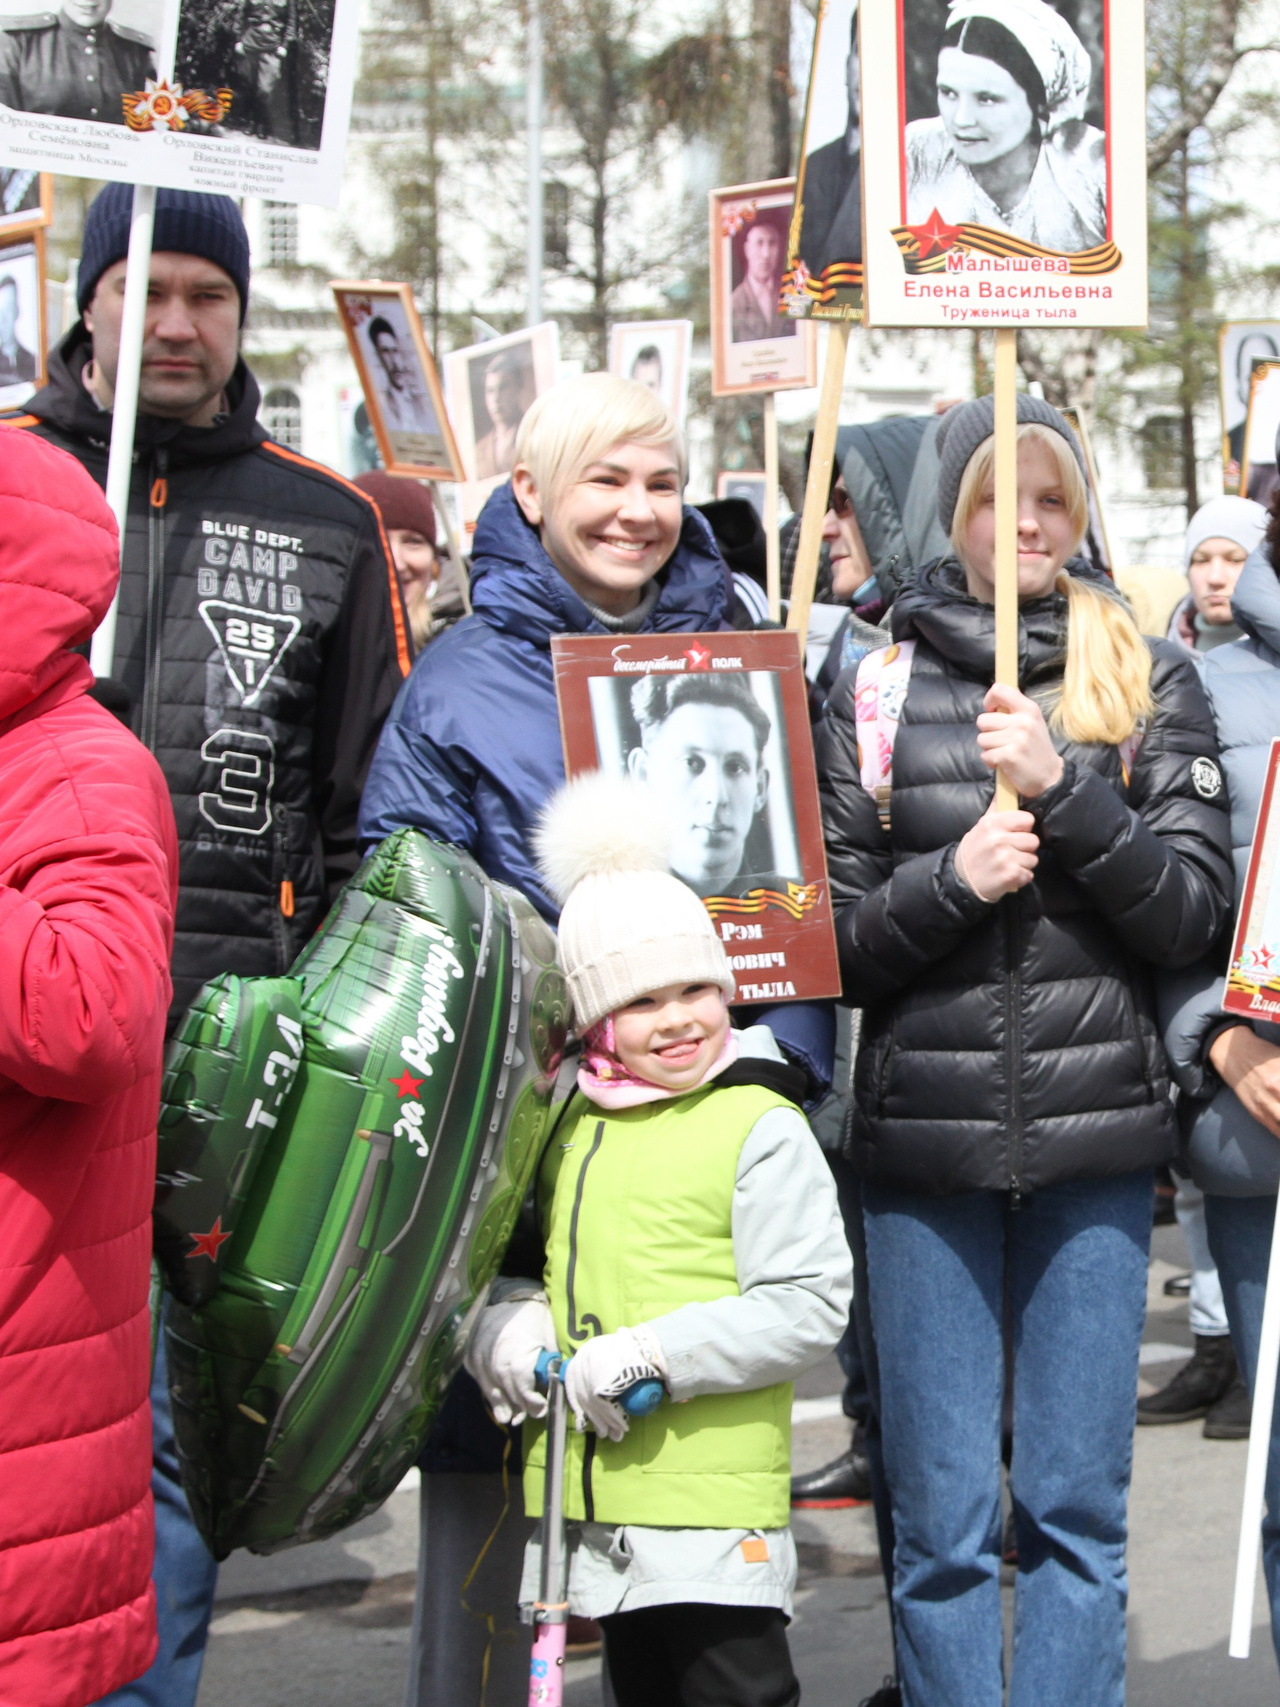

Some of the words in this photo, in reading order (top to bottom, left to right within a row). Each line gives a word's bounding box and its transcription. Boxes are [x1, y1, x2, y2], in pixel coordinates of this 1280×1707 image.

[946, 252, 1069, 273] Малышева
[903, 281, 970, 298] Елена
[979, 281, 1113, 299] Васильевна
[941, 304, 1031, 321] Труженица
[1036, 307, 1078, 319] тыла
[202, 520, 250, 540] BLUE
[254, 529, 305, 553] DEPT.
[204, 537, 298, 580] CAMP
[197, 567, 303, 613] DAVID
[226, 617, 275, 651] 25
[199, 728, 276, 835] 3
